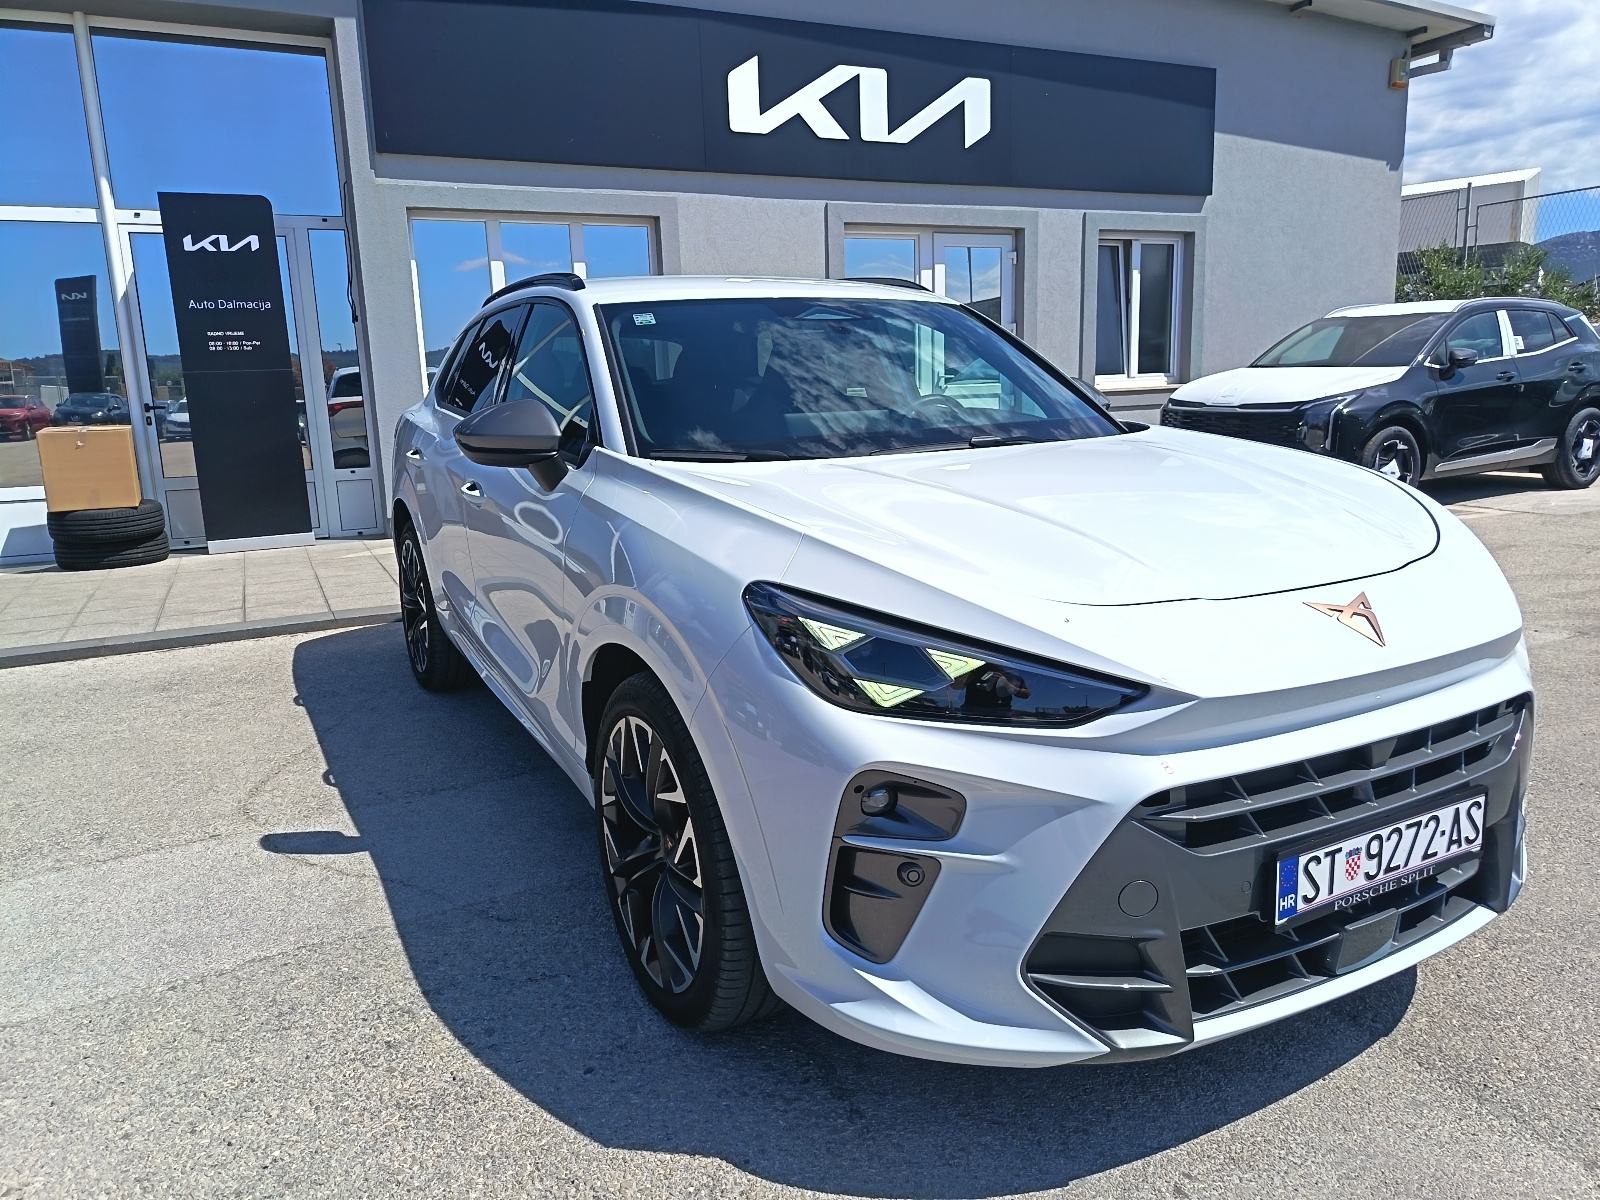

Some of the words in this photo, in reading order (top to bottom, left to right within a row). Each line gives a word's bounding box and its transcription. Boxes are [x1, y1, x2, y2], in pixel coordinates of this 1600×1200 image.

[727, 55, 991, 149] KIA
[182, 233, 260, 252] KIA
[188, 300, 215, 309] Auto
[218, 299, 272, 311] Dalmacija
[1301, 846, 1343, 905] ST
[1334, 881, 1398, 911] PORSCHE
[1401, 865, 1436, 887] SPLIT
[1279, 893, 1295, 912] HR
